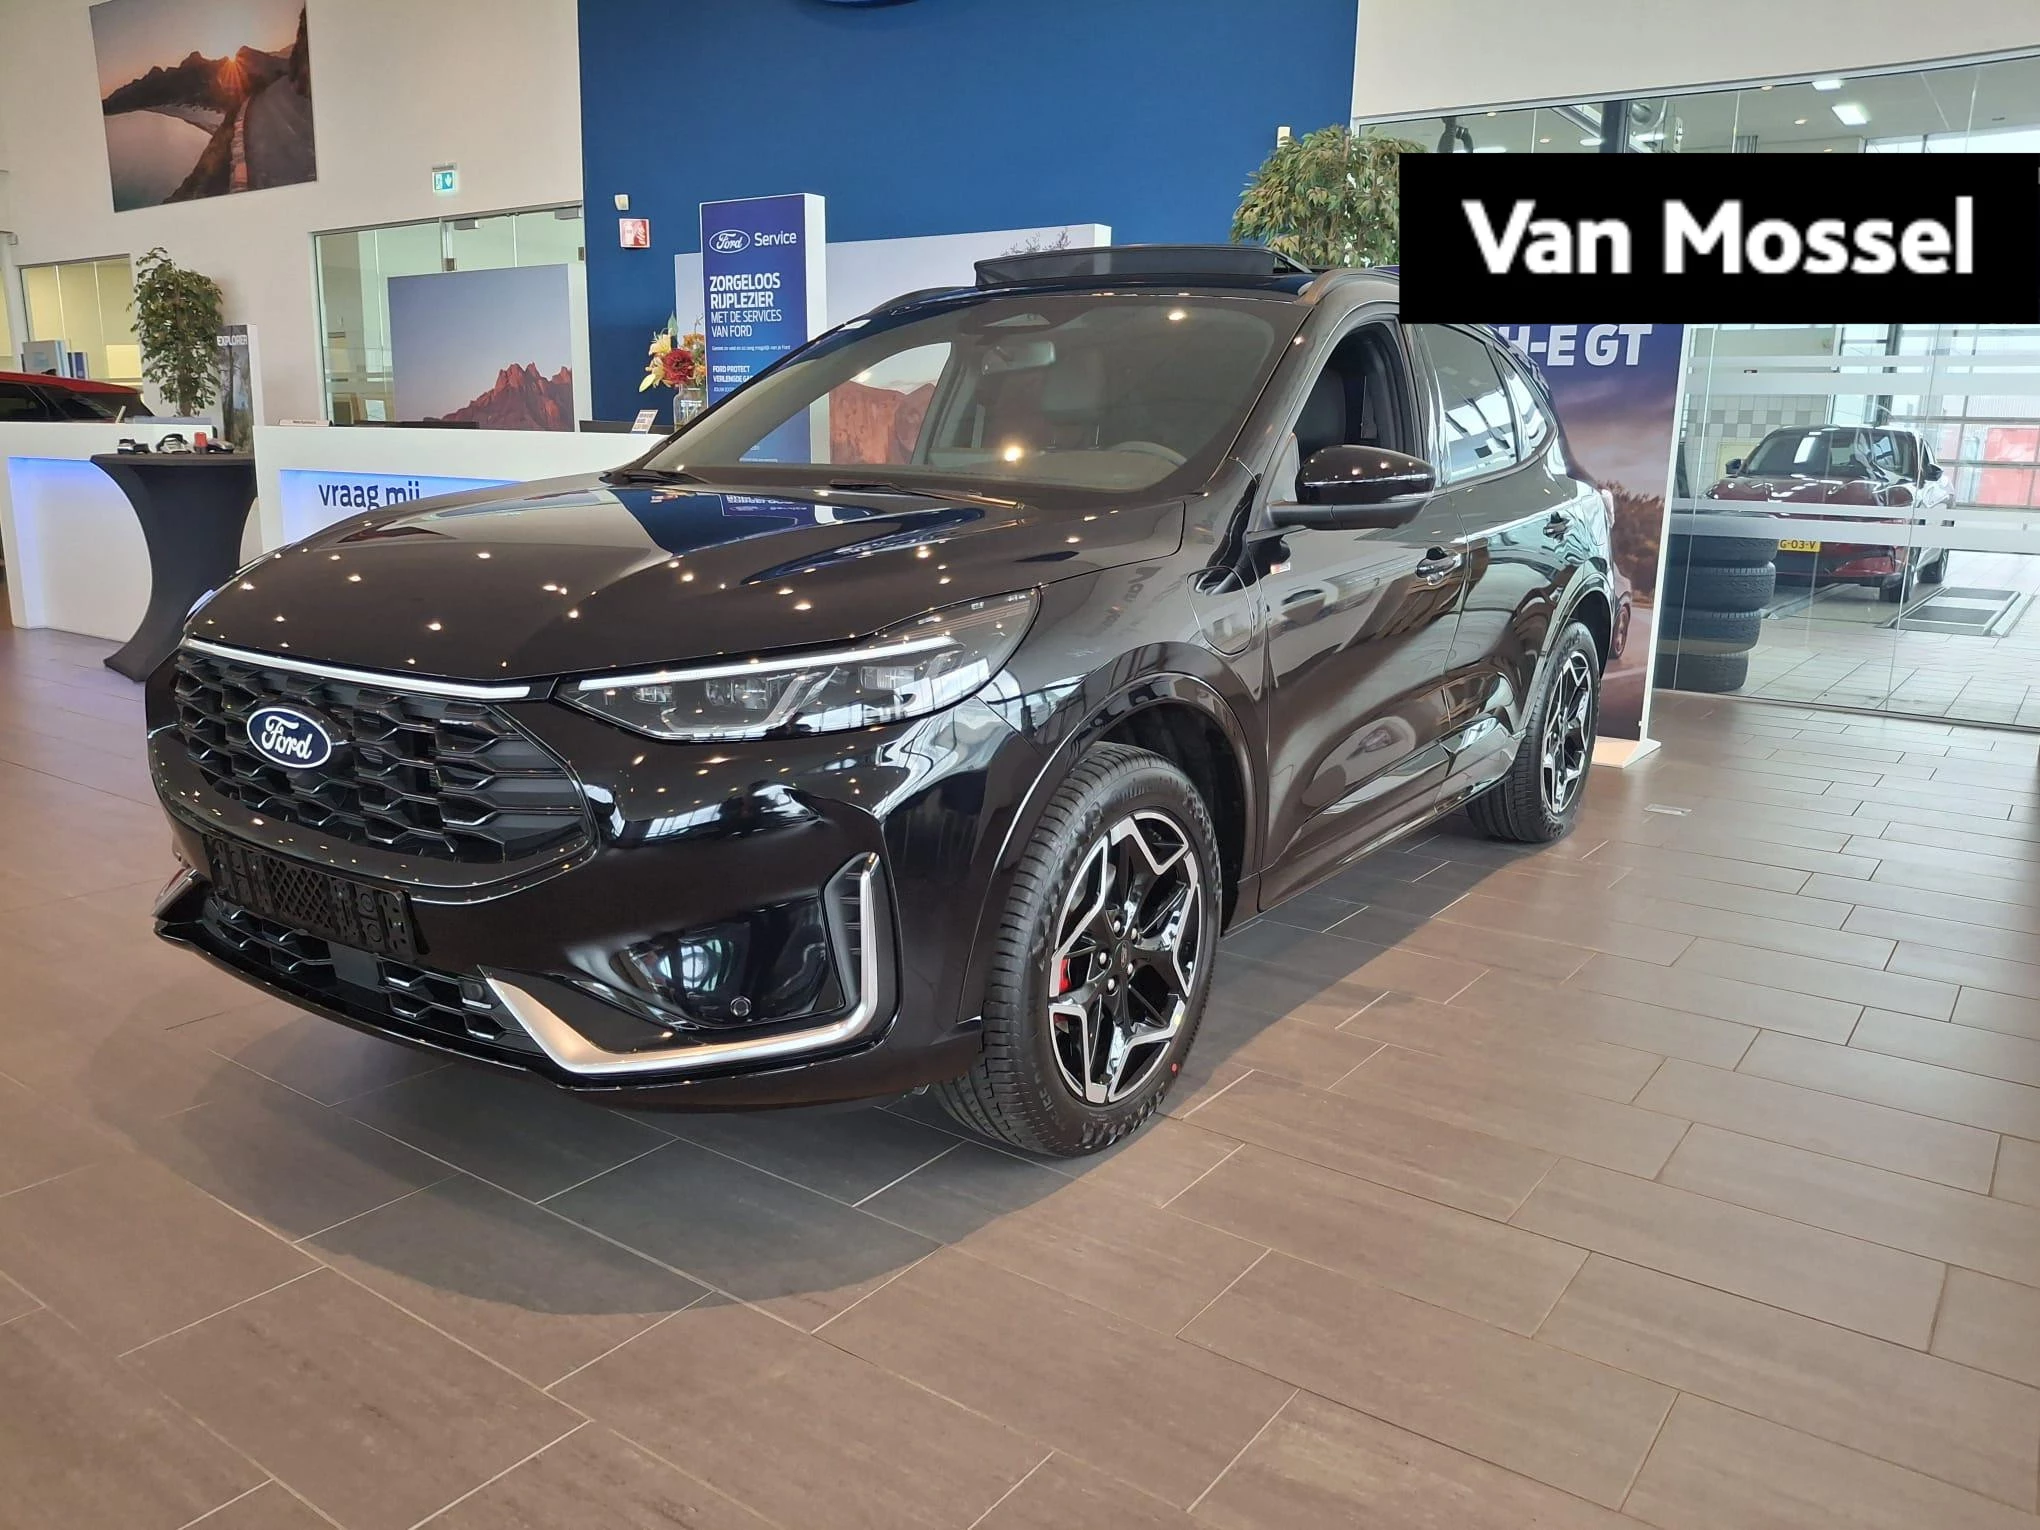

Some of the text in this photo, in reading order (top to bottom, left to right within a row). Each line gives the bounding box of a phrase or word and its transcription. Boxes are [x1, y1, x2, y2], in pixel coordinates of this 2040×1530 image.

[716, 230, 797, 250] Ford Service
[709, 272, 781, 292] ZORGELOOS
[710, 291, 774, 309] RIJPLEZIER
[711, 309, 782, 324] MET DE SERVICES
[216, 335, 248, 346] EXPLORER
[711, 324, 752, 338] VAN FORD
[1584, 323, 1653, 366] GT
[712, 365, 750, 373] FORD PROTECT
[318, 484, 380, 511] vraag
[261, 715, 313, 760] Ford
